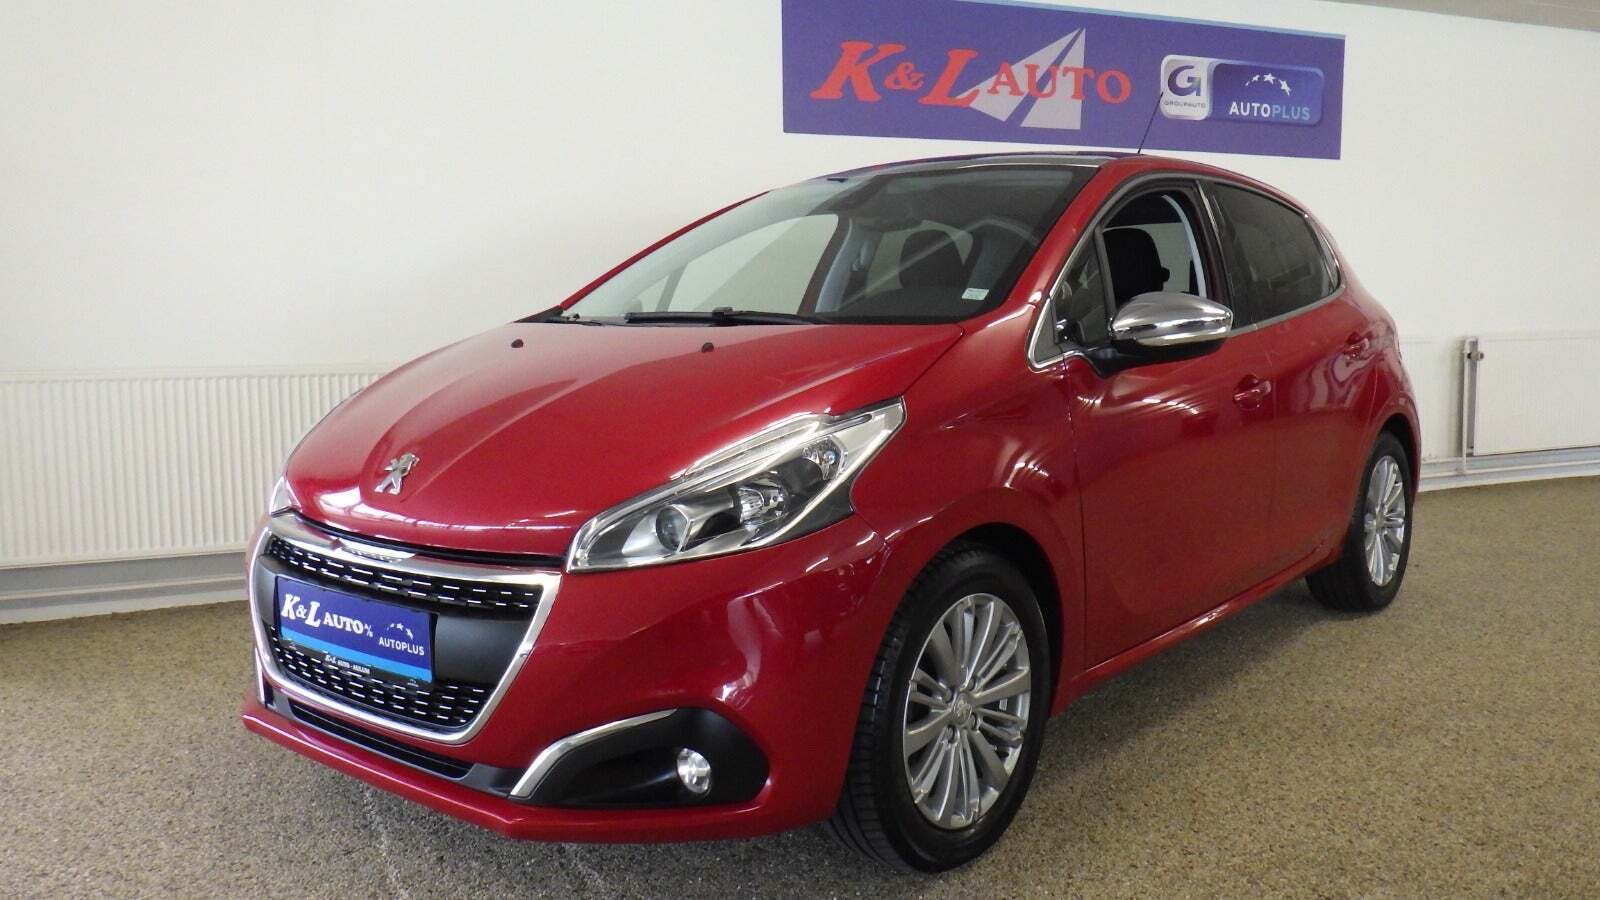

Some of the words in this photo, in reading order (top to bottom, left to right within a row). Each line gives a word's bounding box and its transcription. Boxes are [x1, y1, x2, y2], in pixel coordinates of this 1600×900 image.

[810, 40, 980, 108] K&L
[988, 61, 1133, 104] AUTO
[1228, 101, 1311, 121] AUTOPLUS
[280, 593, 321, 628] K&L
[323, 611, 364, 635] AUTO
[378, 636, 425, 656] AUTOPLUS
